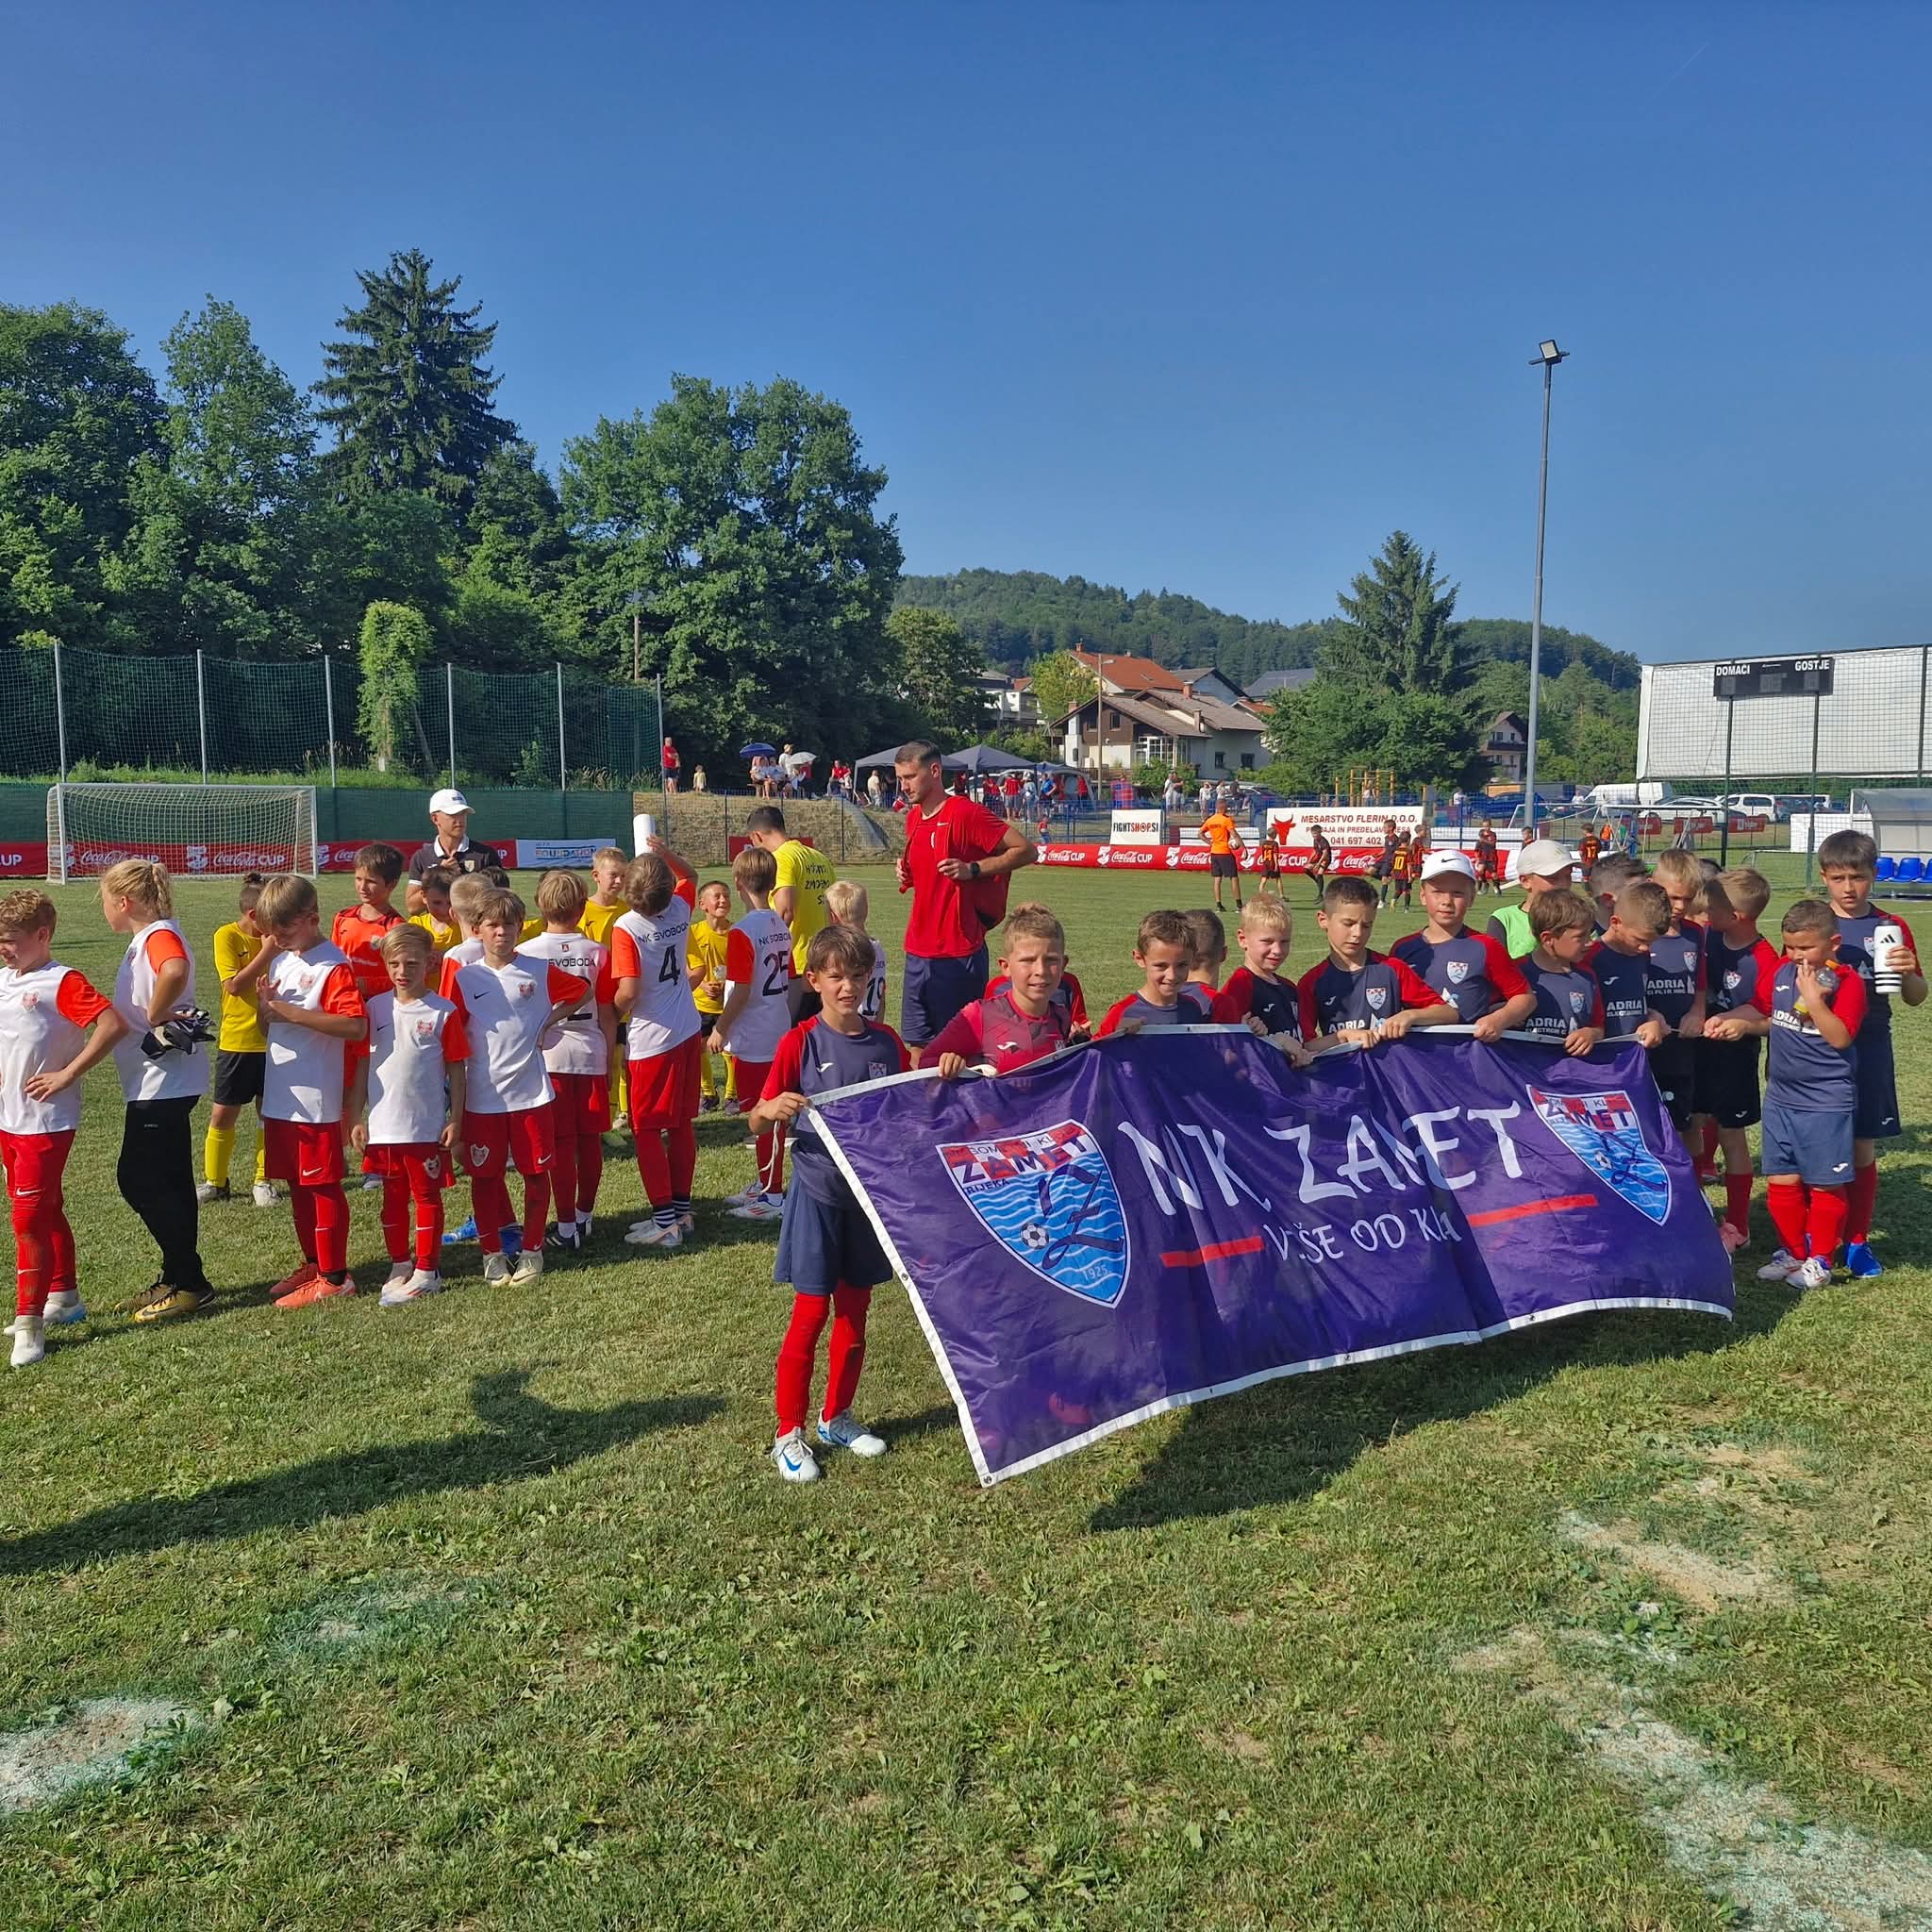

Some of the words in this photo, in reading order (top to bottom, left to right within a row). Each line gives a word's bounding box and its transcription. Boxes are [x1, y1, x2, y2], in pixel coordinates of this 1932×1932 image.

[1794, 659, 1829, 671] GOSTJE
[1391, 814, 1417, 823] D.O.O.
[0, 854, 22, 866] UP
[258, 855, 286, 866] CUP
[1071, 852, 1085, 861] CUP
[1137, 853, 1153, 862] CUP
[1289, 856, 1308, 866] CUP
[1393, 857, 1405, 870] 10
[638, 934, 653, 943] NK
[548, 958, 596, 967] SVOBODA
[658, 944, 680, 986] 4
[762, 950, 789, 996] 25
[1647, 978, 1685, 990] ADRIA
[1607, 999, 1642, 1011] ADRIA
[1328, 1019, 1366, 1034] ADRIA
[1525, 1017, 1566, 1028] ADRIA
[953, 1136, 1087, 1183] ZAMET
[1118, 1121, 1272, 1216] NK
[965, 1178, 1010, 1195] RIJEKA
[1263, 1222, 1344, 1264] VŠE
[1350, 1213, 1406, 1252] OD
